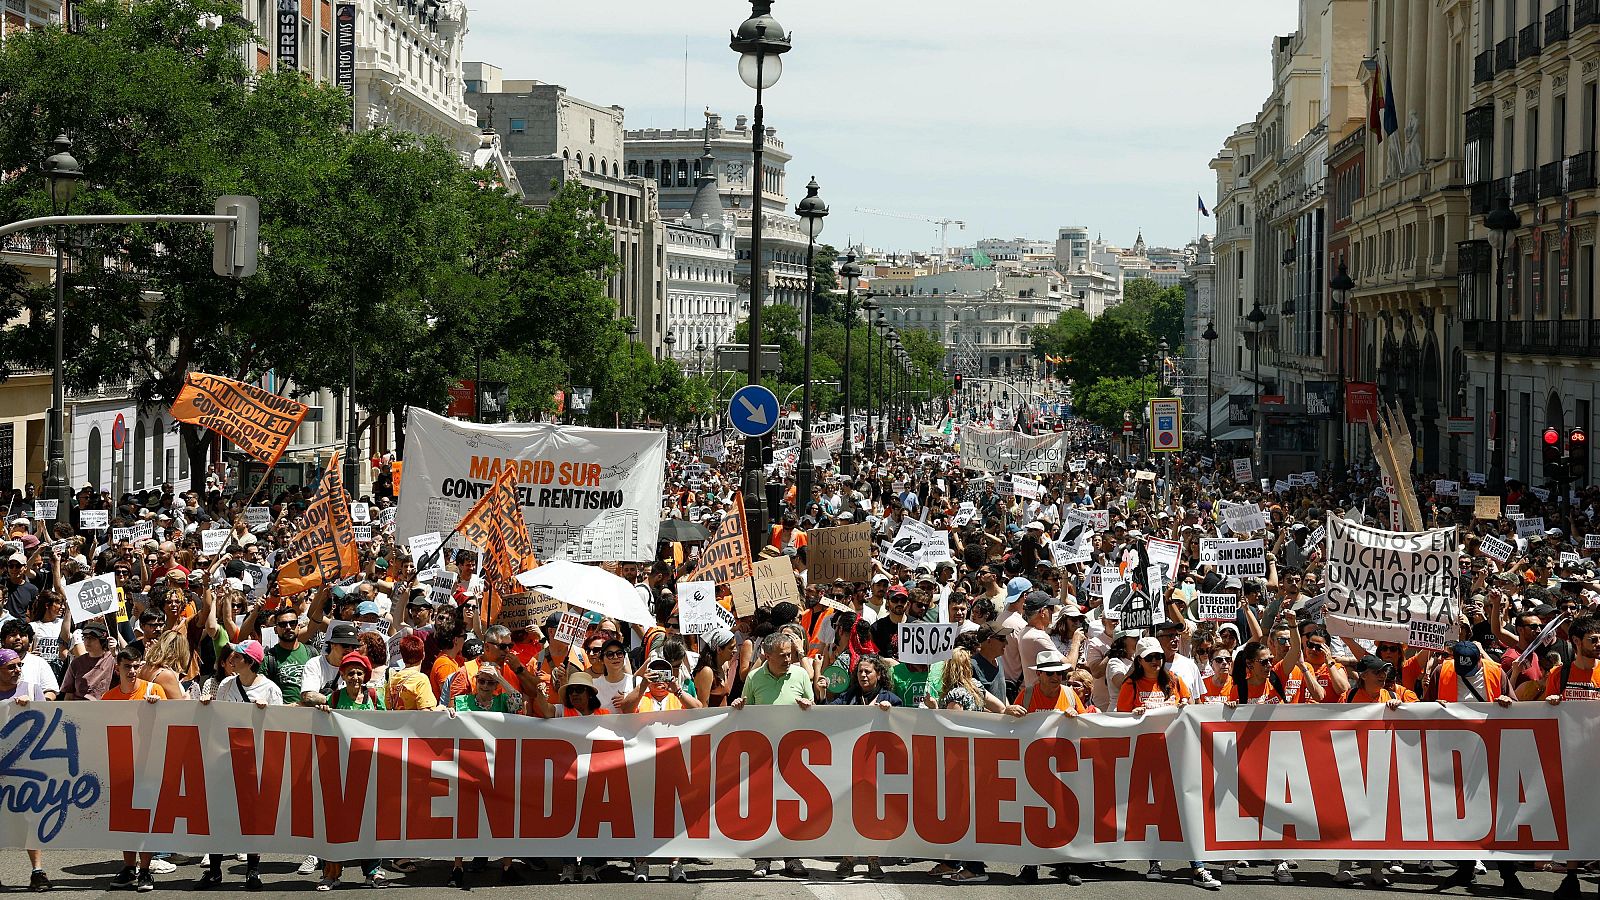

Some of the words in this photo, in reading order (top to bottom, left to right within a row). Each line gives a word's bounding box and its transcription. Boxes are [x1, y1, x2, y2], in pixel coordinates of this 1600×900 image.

[340, 23, 352, 47] VIVAS
[558, 461, 602, 487] SUR
[538, 488, 623, 511] RENTISMO
[1332, 519, 1422, 552] VECINOS
[1431, 530, 1456, 553] EN
[1485, 535, 1512, 554] DERECHO
[833, 547, 864, 559] MENOS
[1218, 549, 1232, 560] SIN
[1234, 547, 1264, 560] CASA?
[1487, 544, 1508, 559] TECHO
[813, 562, 868, 580] BUITRES
[1225, 564, 1237, 575] LA
[1411, 553, 1454, 578] POR
[80, 584, 110, 600] STOP
[1199, 596, 1236, 605] DERECHO
[1199, 605, 1205, 613] A
[1207, 605, 1236, 614] TECHO
[1327, 588, 1412, 624] SAREB
[1411, 621, 1445, 635] DERECHO
[1410, 632, 1416, 640] A
[1418, 632, 1445, 643] TECHO
[0, 708, 79, 781] 24
[107, 725, 210, 835] LA
[228, 727, 636, 844] VIVIENDA
[653, 729, 834, 842] NOS
[852, 731, 1184, 849] CUESTA
[1213, 730, 1321, 842] LA
[1330, 728, 1560, 842] VIDA
